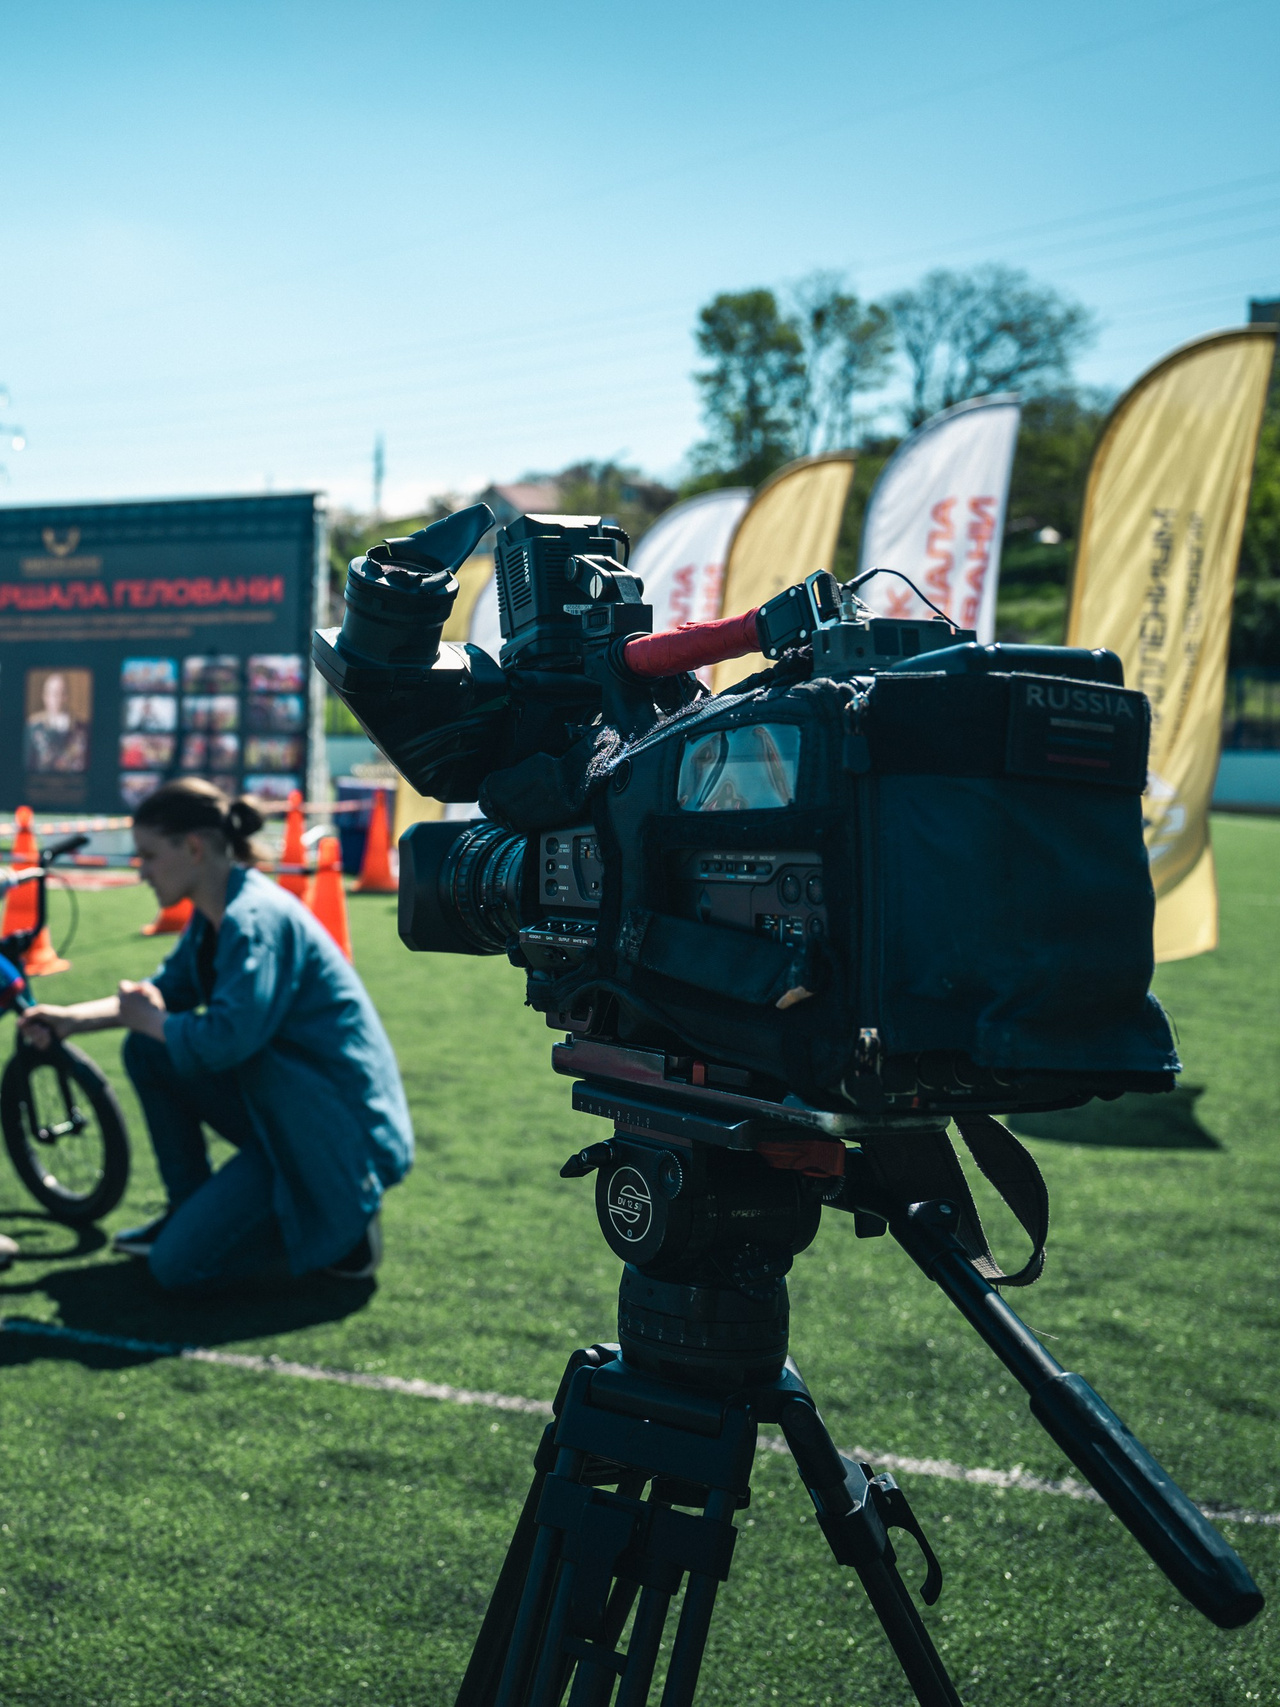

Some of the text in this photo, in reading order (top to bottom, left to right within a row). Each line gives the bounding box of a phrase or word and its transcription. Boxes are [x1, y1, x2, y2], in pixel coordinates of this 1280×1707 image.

[112, 574, 286, 609] ГЕЛОВАНИ
[1026, 684, 1134, 719] RUSSIA
[618, 1197, 625, 1206] DV
[627, 1200, 633, 1208] 12
